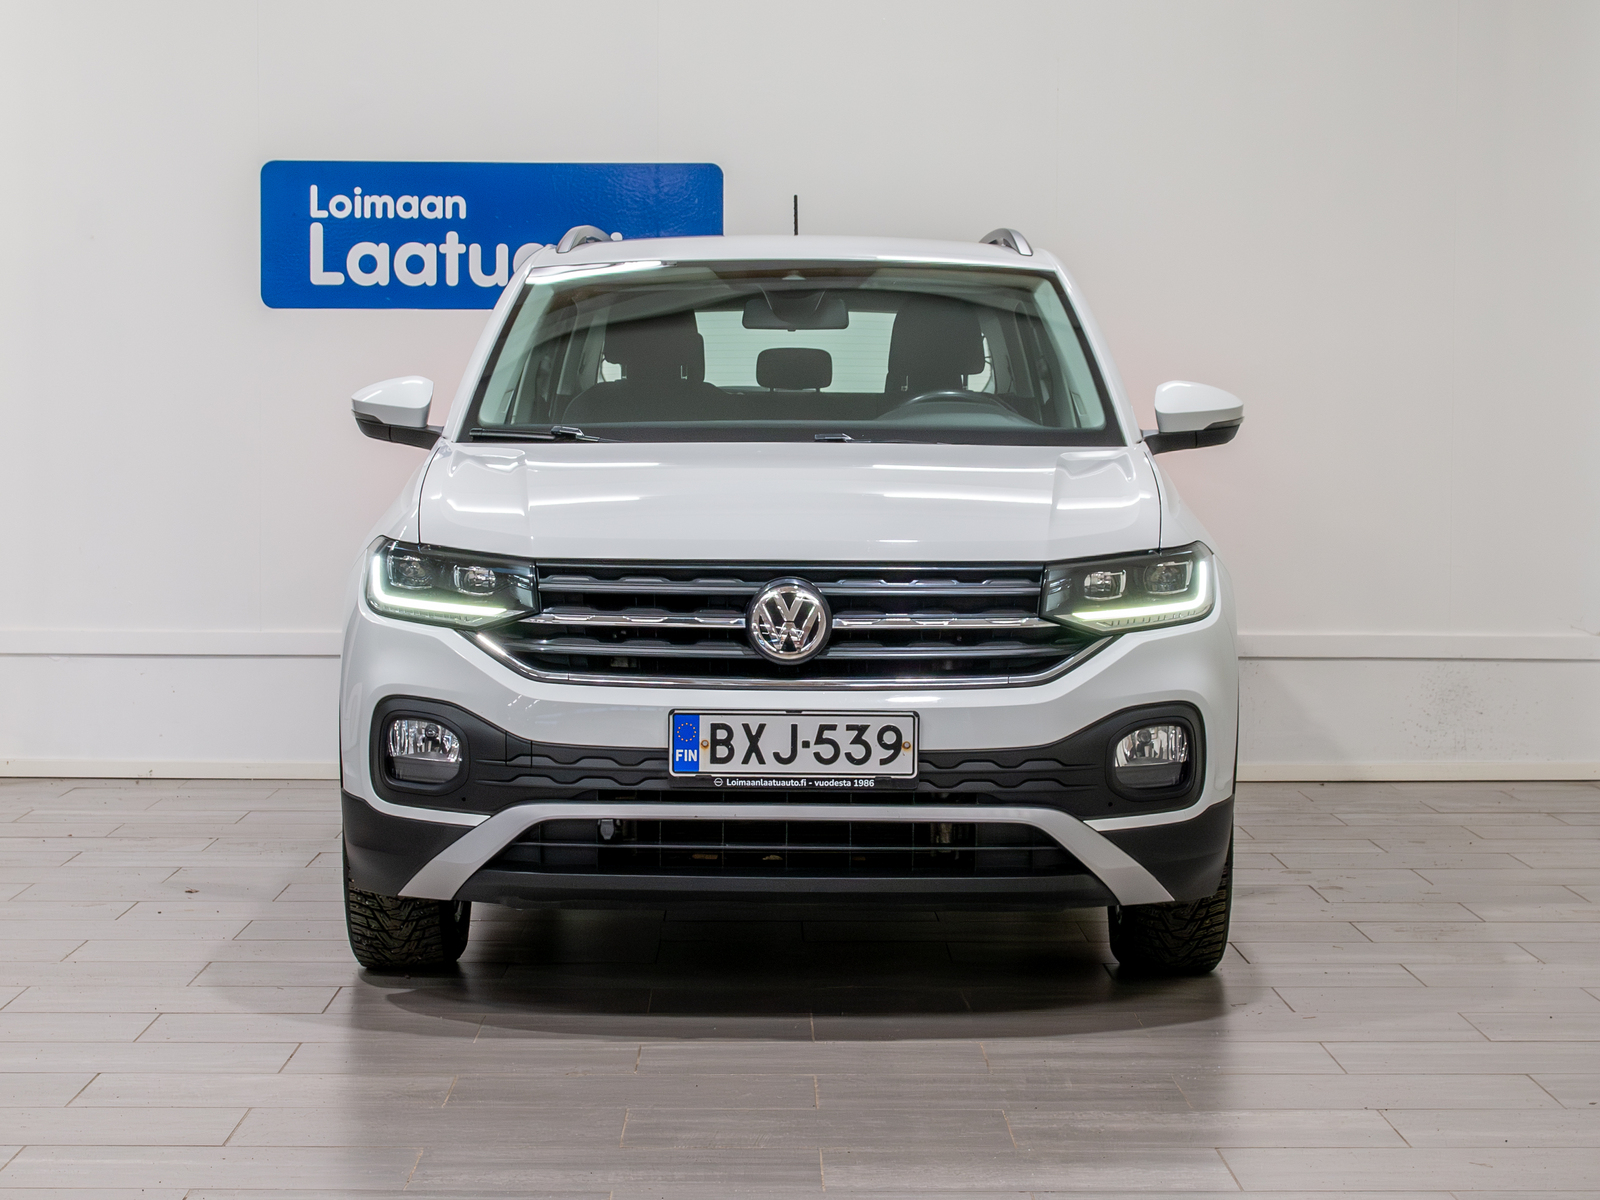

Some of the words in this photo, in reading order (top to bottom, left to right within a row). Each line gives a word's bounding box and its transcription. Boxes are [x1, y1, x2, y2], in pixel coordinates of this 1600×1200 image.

[309, 184, 466, 219] Loimaan
[309, 222, 623, 287] Laatu
[675, 749, 698, 762] FIN
[709, 722, 903, 766] BXJ-539
[726, 778, 807, 787] Loimaanlaatuauto.fi
[814, 779, 852, 787] vuodesta
[853, 779, 875, 788] 1986
